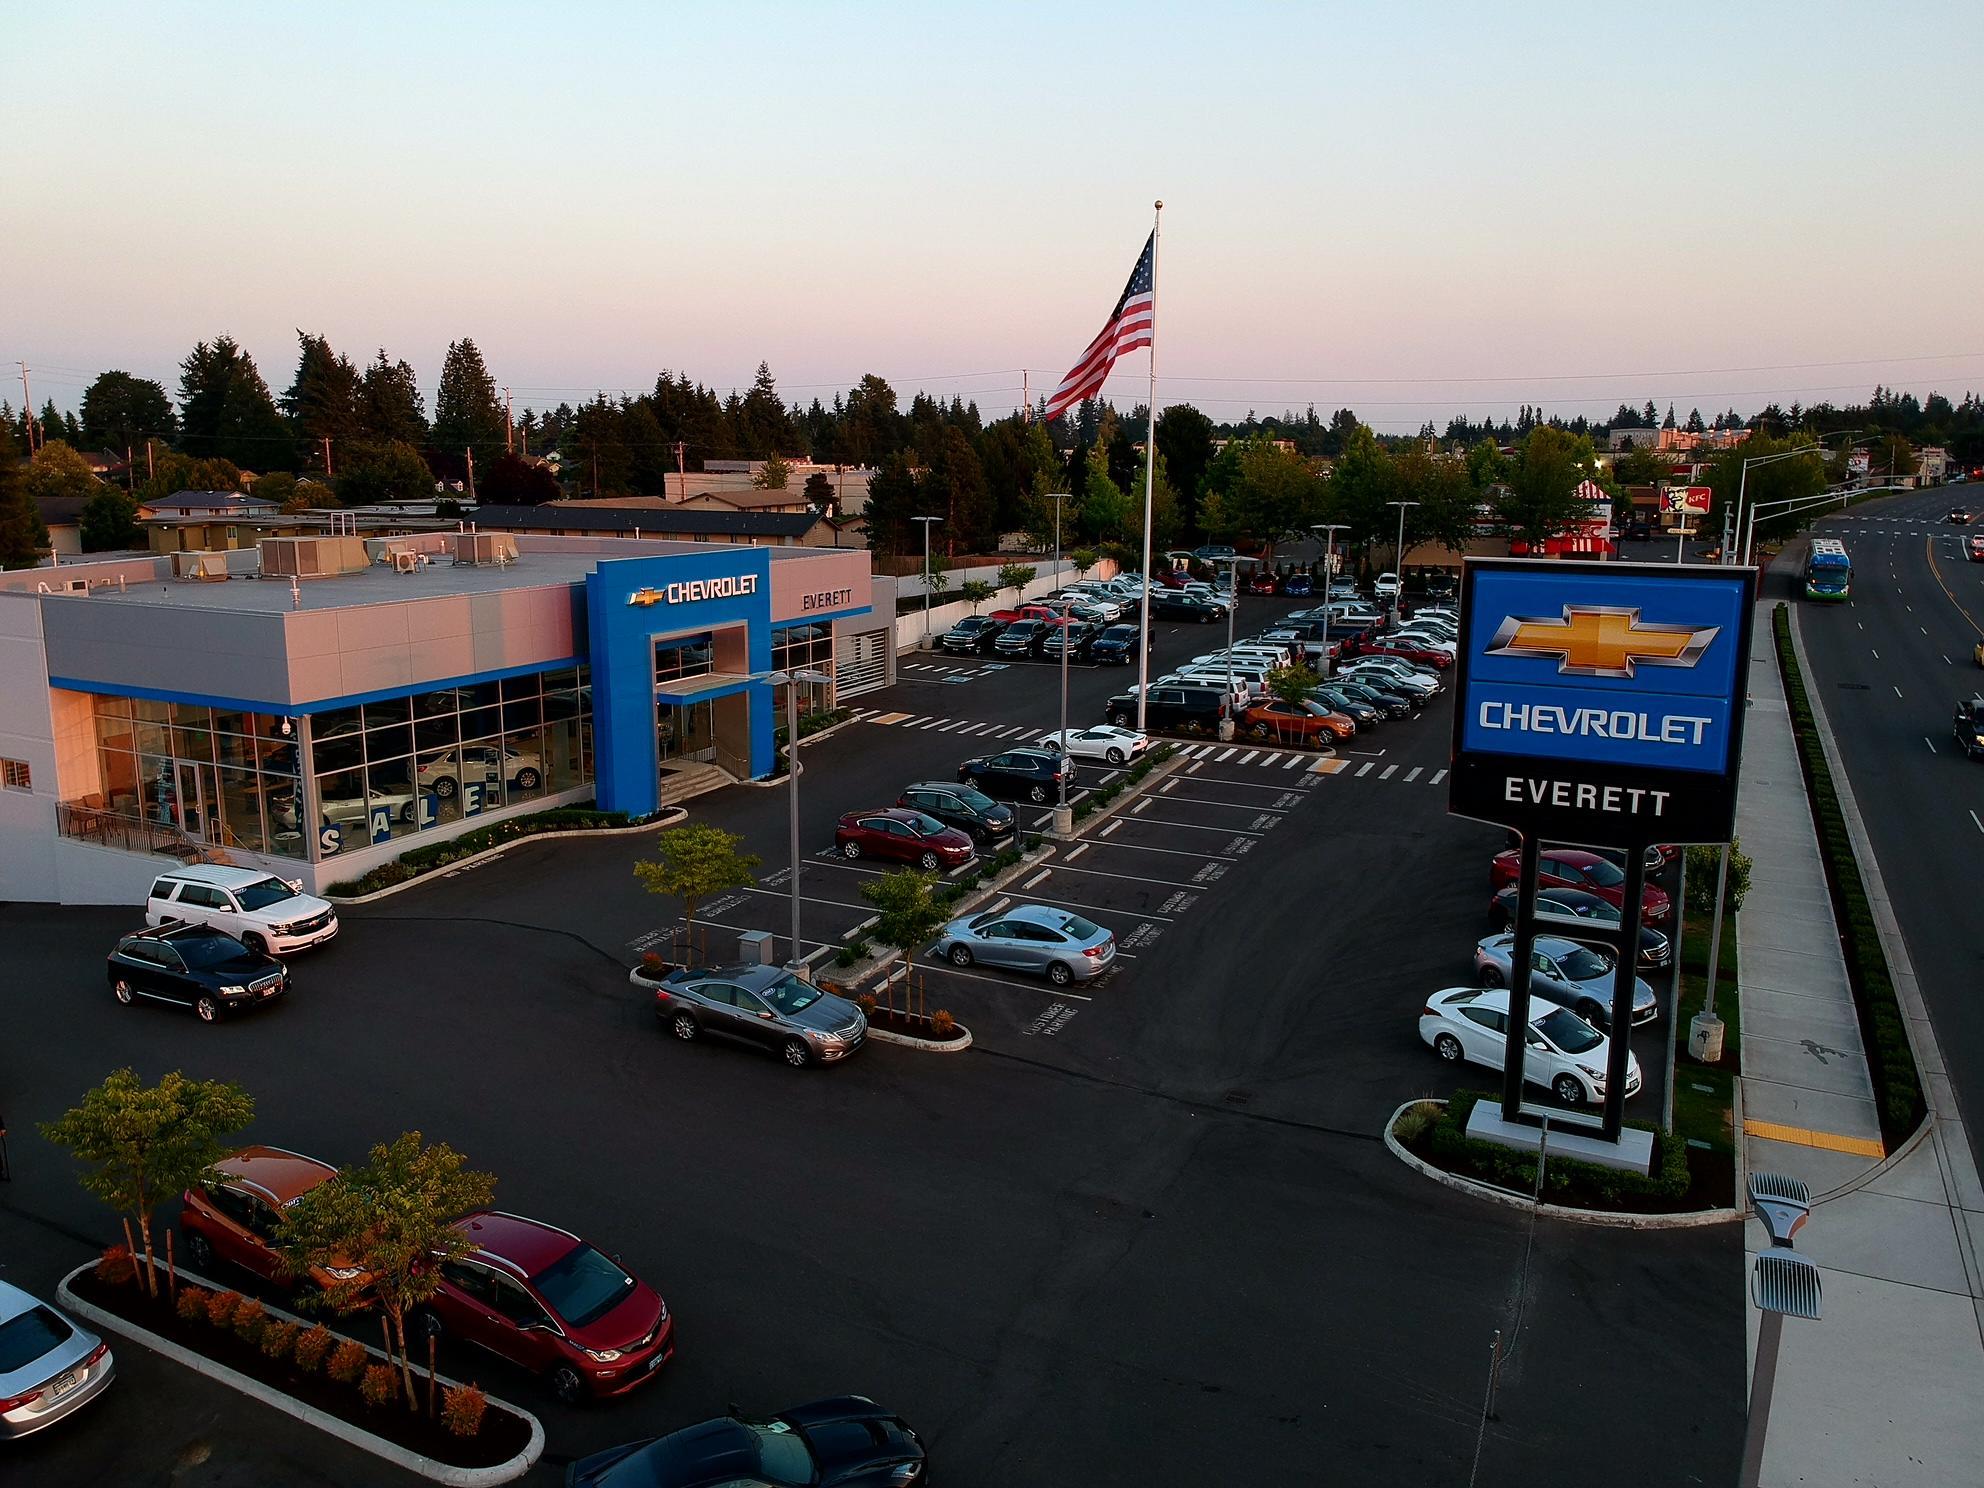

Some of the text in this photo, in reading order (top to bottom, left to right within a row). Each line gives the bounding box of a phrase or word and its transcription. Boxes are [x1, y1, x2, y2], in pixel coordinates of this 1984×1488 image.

[1688, 493, 1706, 503] KFC
[667, 574, 758, 604] CHEVROLET
[803, 588, 852, 610] EVERETT
[1479, 701, 1713, 745] CHEVROLET
[1505, 777, 1670, 817] EVERETT
[1042, 1007, 1079, 1036] PARKING
